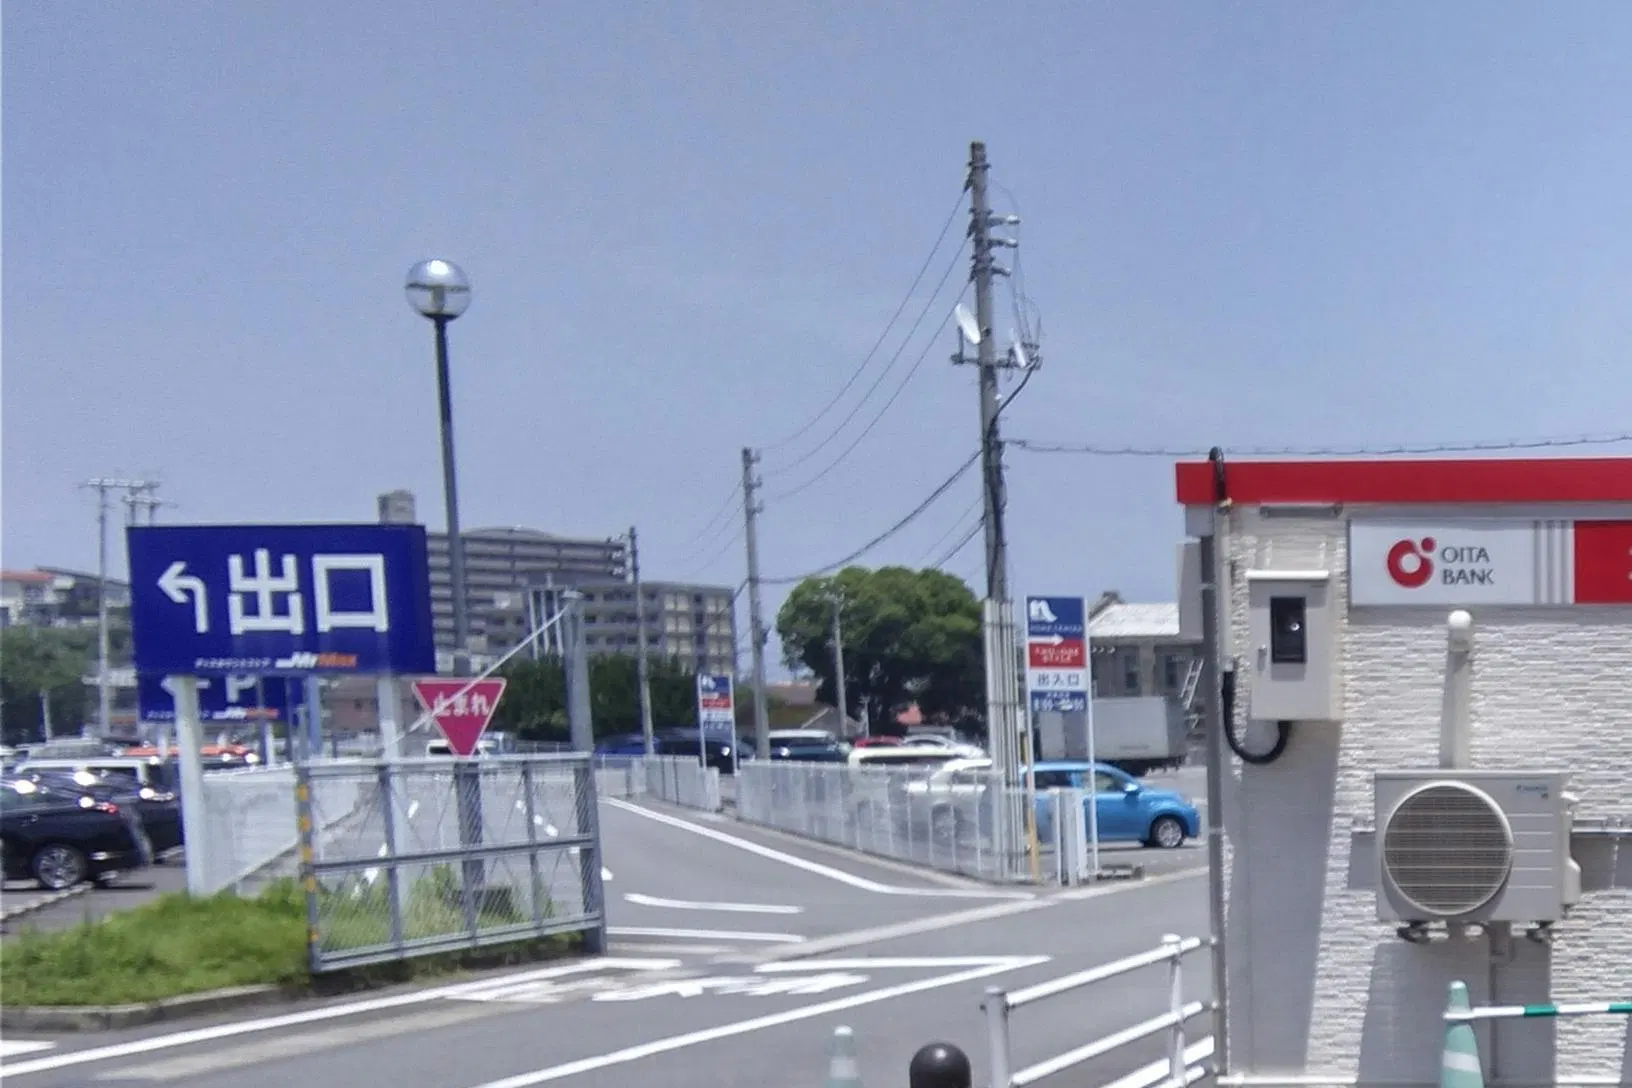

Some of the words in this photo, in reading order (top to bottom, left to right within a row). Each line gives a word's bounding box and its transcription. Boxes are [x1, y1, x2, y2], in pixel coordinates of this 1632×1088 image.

[1441, 546, 1490, 563] OITA
[1441, 568, 1495, 585] BANK
[228, 548, 389, 635] 出口
[433, 691, 489, 717] 止まれ
